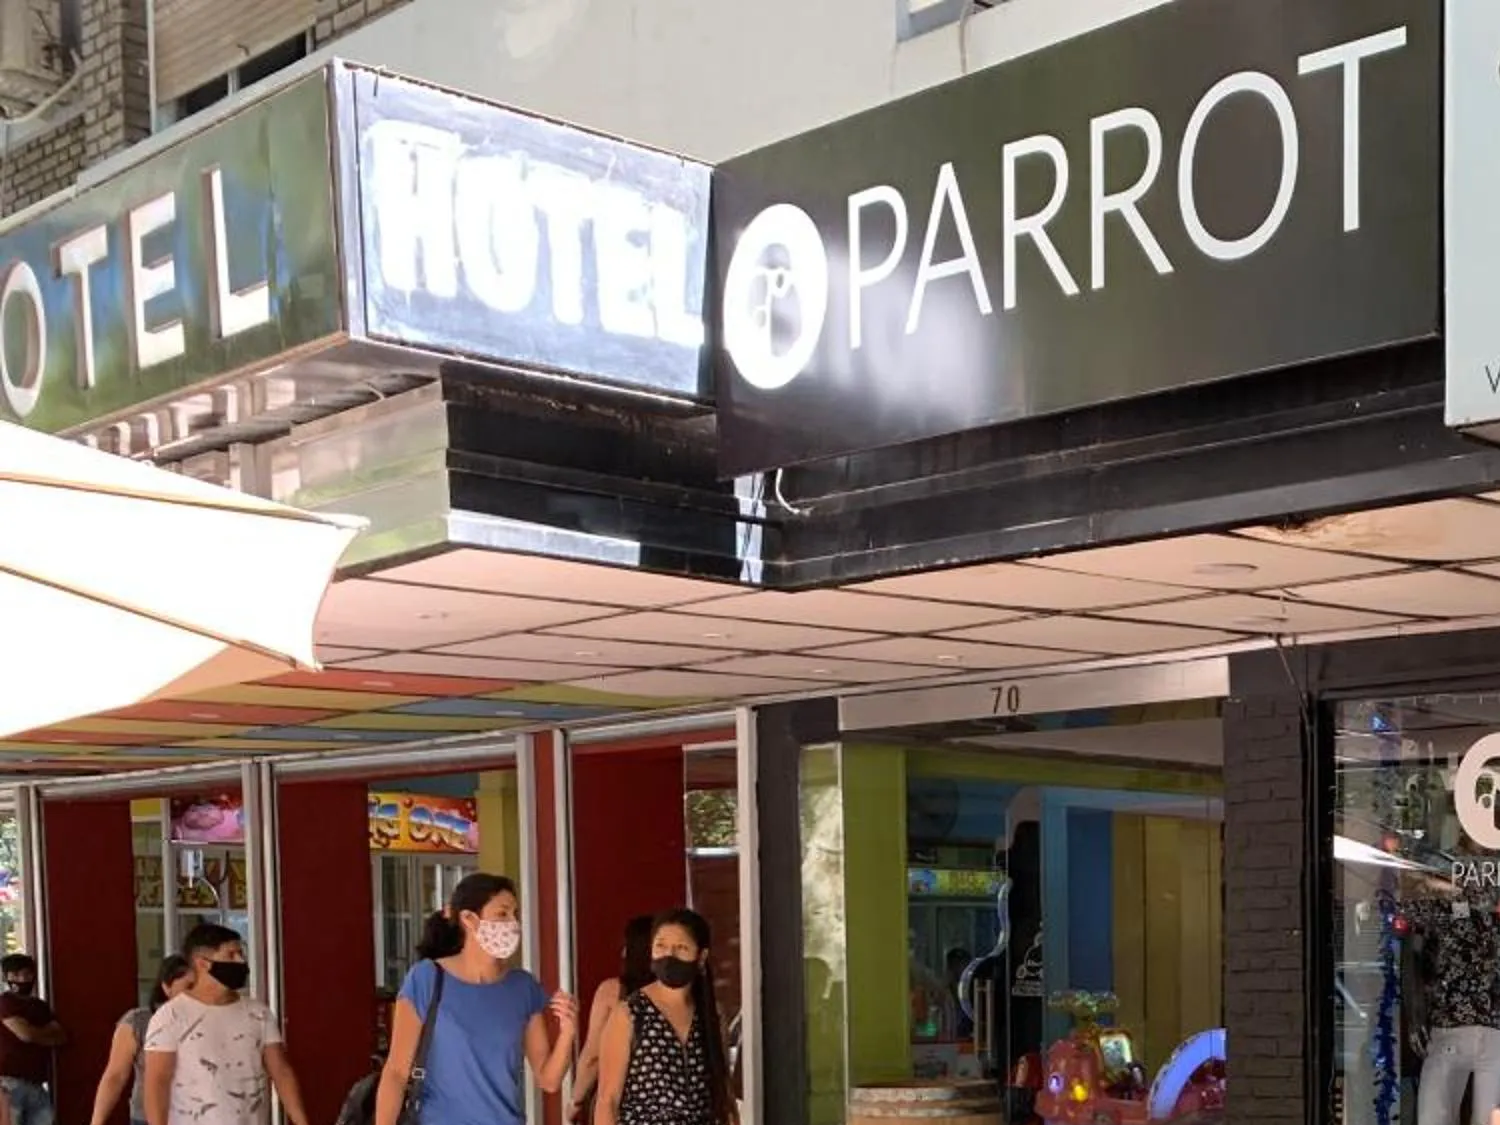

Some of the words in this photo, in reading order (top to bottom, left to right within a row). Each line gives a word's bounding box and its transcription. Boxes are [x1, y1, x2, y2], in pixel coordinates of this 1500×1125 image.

[365, 119, 704, 347] HOTEL
[847, 26, 1407, 350] PARROT
[989, 684, 1020, 715] 70
